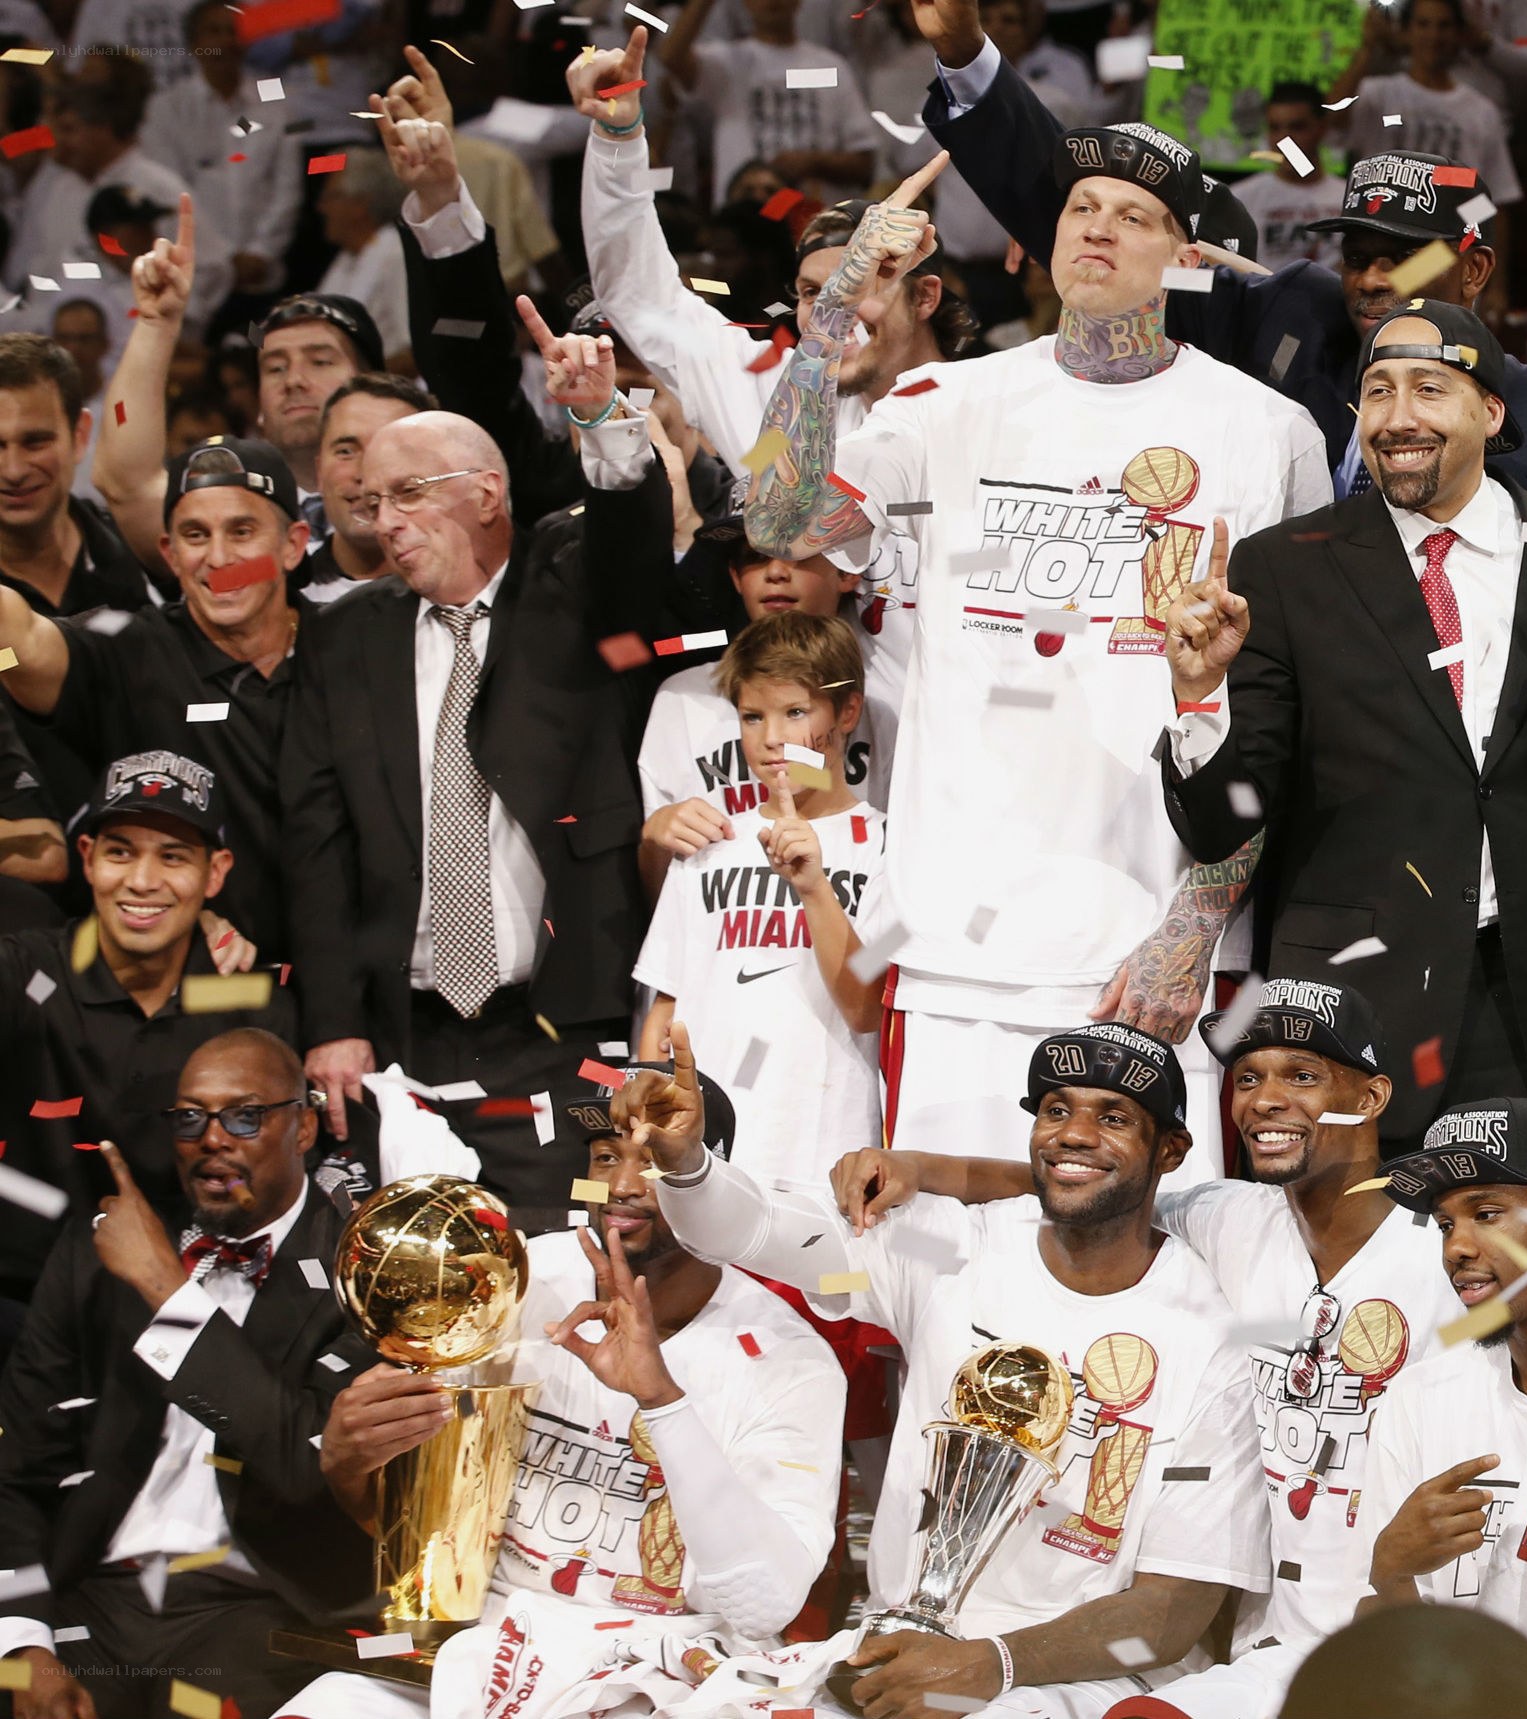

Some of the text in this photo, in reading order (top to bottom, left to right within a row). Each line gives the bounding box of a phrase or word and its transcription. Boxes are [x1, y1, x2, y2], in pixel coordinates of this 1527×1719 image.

[1066, 138, 1104, 167] 20
[1136, 152, 1170, 185] 13
[1404, 158, 1435, 170] ASSOCIATI
[984, 498, 1148, 540] WHITE
[966, 533, 1152, 600] HOT
[969, 620, 1000, 631] LOCKER
[1116, 643, 1160, 652] CHAMPI
[702, 866, 869, 917] WITNSS
[716, 909, 813, 951] MIAM
[1298, 981, 1342, 995] ASSOCIATION
[1282, 1016, 1313, 1041] 13
[1046, 1045, 1158, 1092] 20 13
[568, 1106, 612, 1130] 20
[1440, 1154, 1478, 1179] 13
[520, 1428, 650, 1497] WHITE
